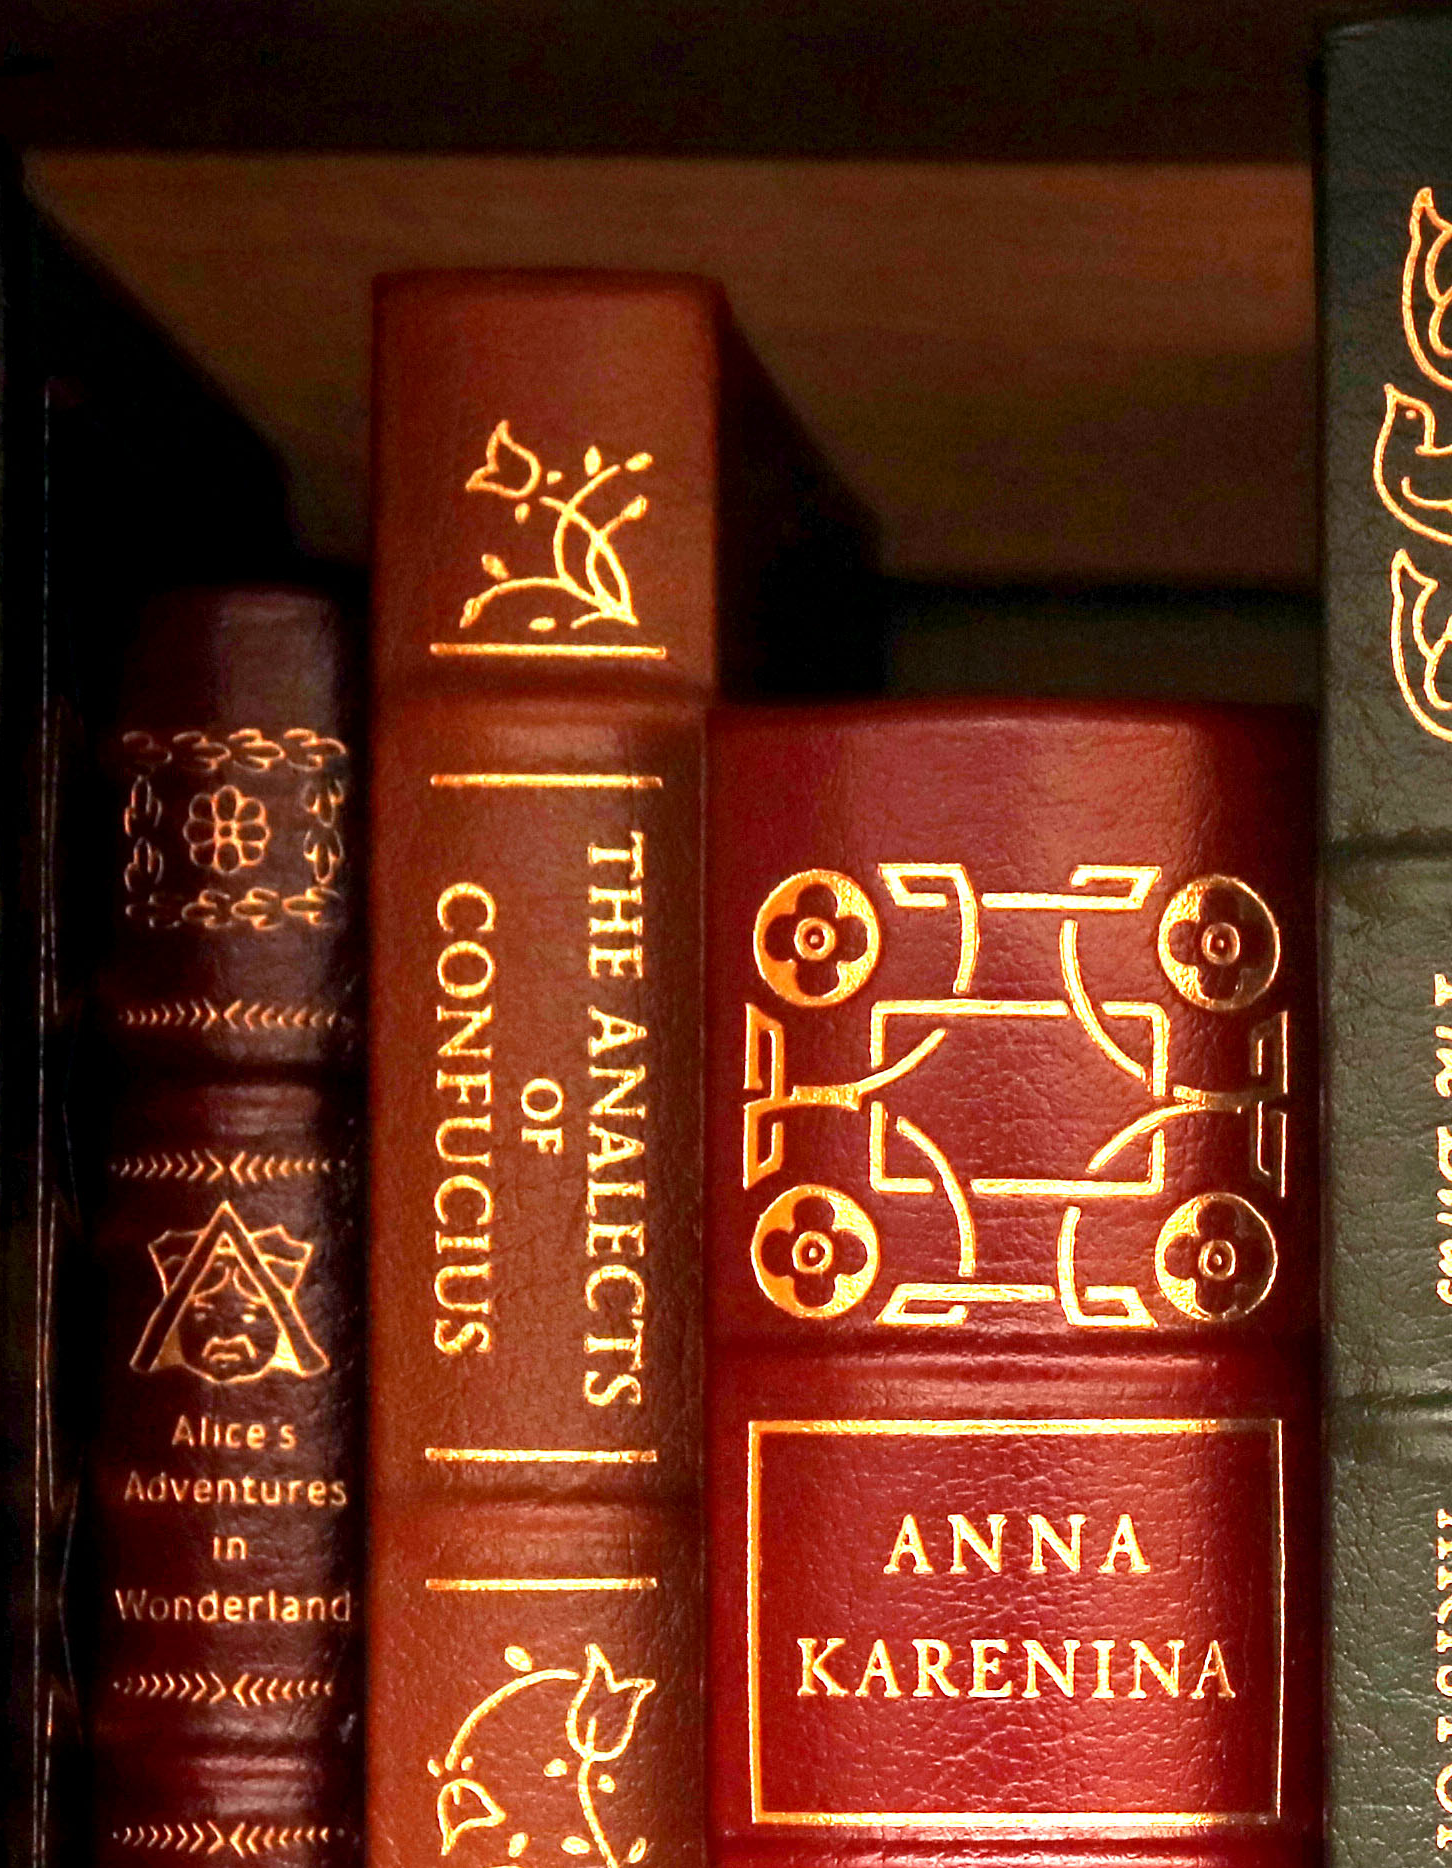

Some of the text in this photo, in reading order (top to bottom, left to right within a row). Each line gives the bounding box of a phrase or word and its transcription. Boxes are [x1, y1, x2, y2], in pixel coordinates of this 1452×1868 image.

[431, 880, 498, 1357] CONFUCIUS
[518, 1076, 566, 1157] OF
[580, 829, 650, 1409] THE ANALECTS
[173, 1413, 298, 1453] Alice's
[123, 1472, 349, 1508] Adventures
[211, 1534, 249, 1563] in
[881, 1511, 1153, 1578] ANNA
[113, 1587, 352, 1626] Wonderland
[794, 1635, 1238, 1705] KARENINA
